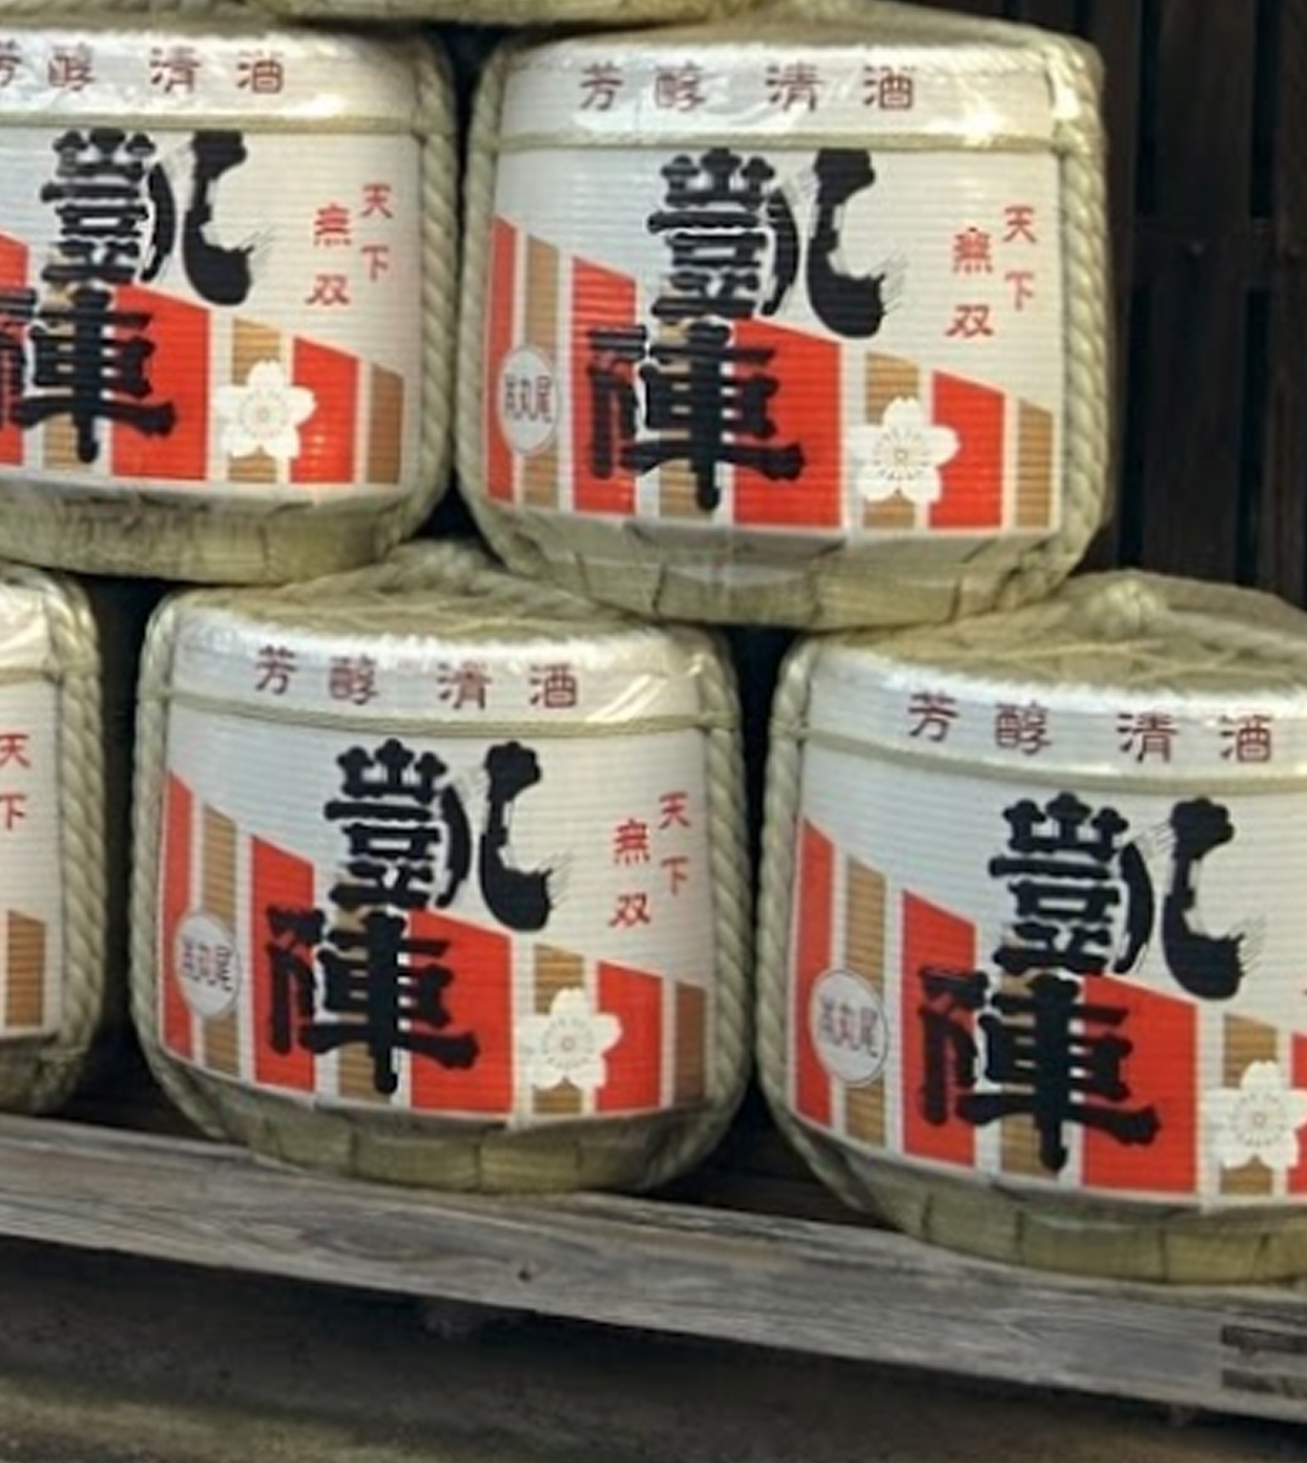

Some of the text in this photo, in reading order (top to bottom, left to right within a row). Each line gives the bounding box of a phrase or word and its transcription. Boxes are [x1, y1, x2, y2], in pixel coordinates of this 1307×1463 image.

[587, 147, 896, 511] 凱陣
[267, 738, 557, 1095] 凱陣
[917, 792, 1247, 1173] 凱陣
